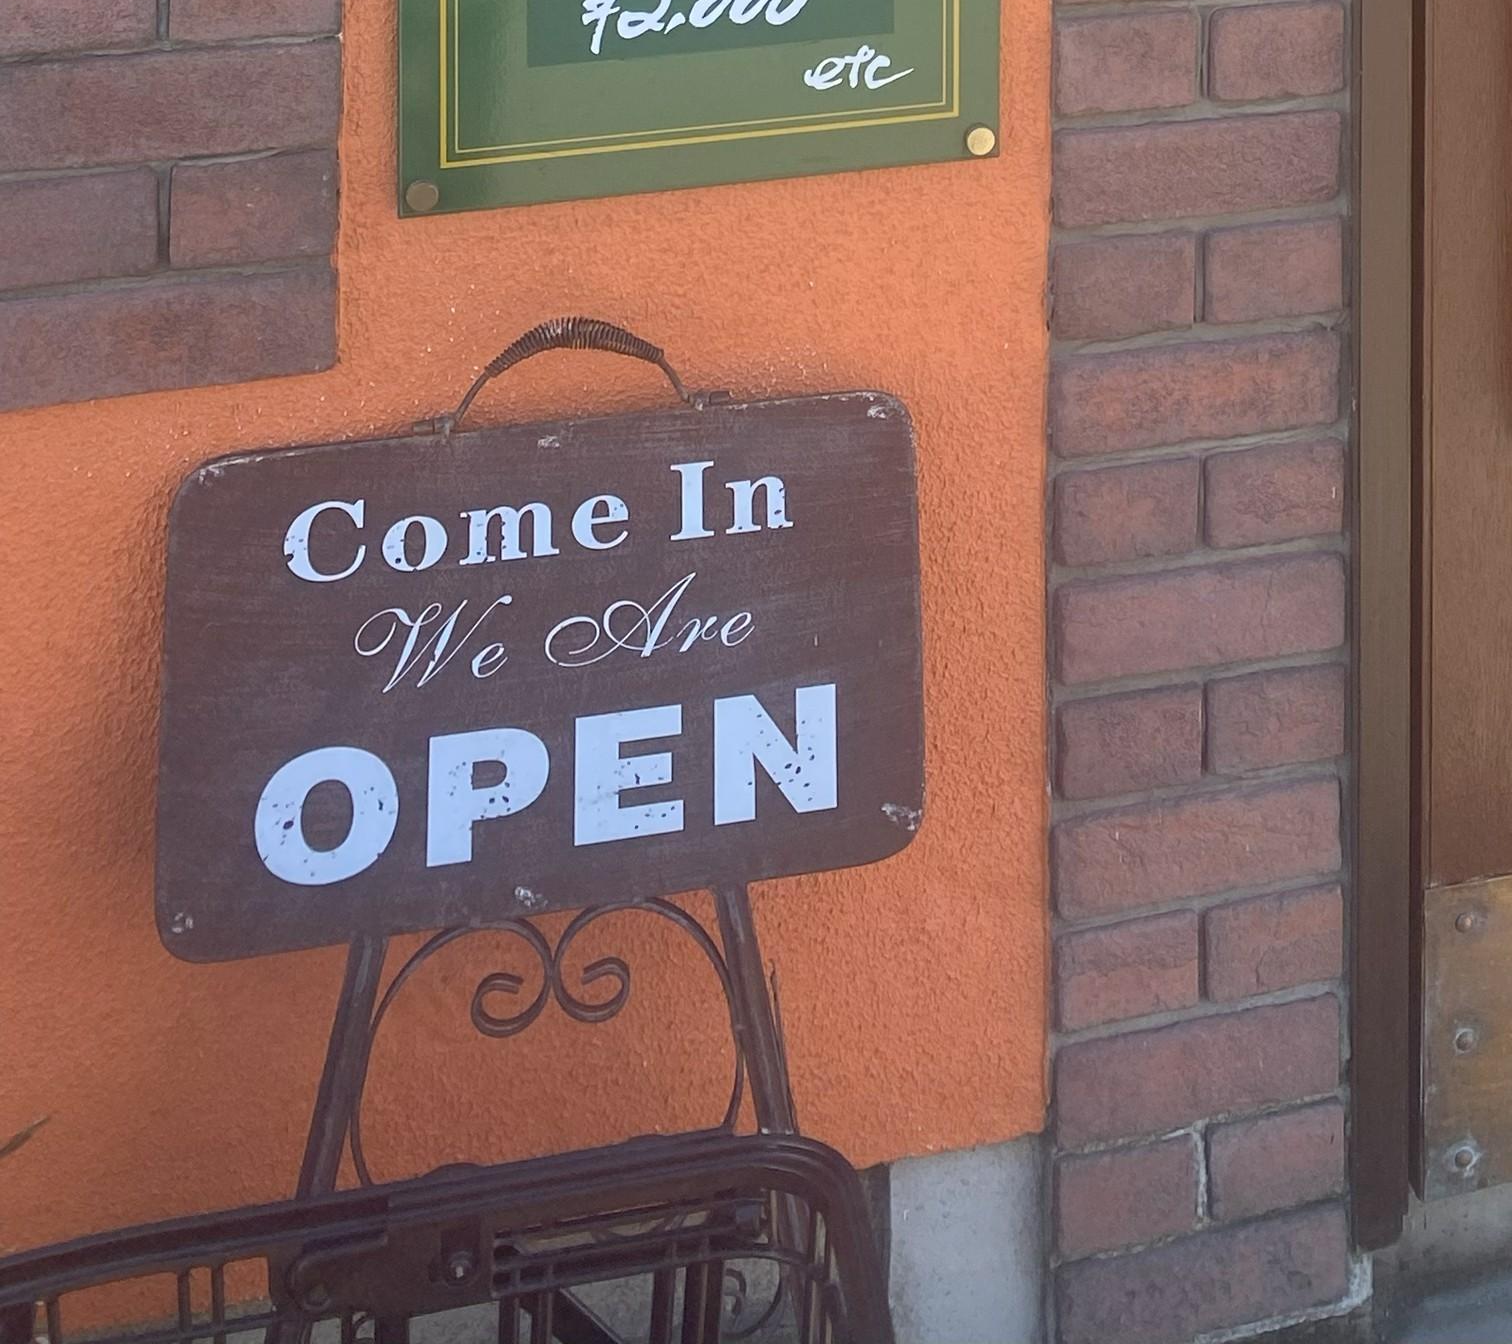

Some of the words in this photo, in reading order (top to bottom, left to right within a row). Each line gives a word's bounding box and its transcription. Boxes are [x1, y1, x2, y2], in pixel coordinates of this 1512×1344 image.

[803, 45, 914, 90] etc
[282, 490, 630, 582] Come
[670, 460, 794, 541] In
[353, 594, 513, 694] We
[544, 572, 756, 667] Are
[254, 683, 838, 886] OPEN
